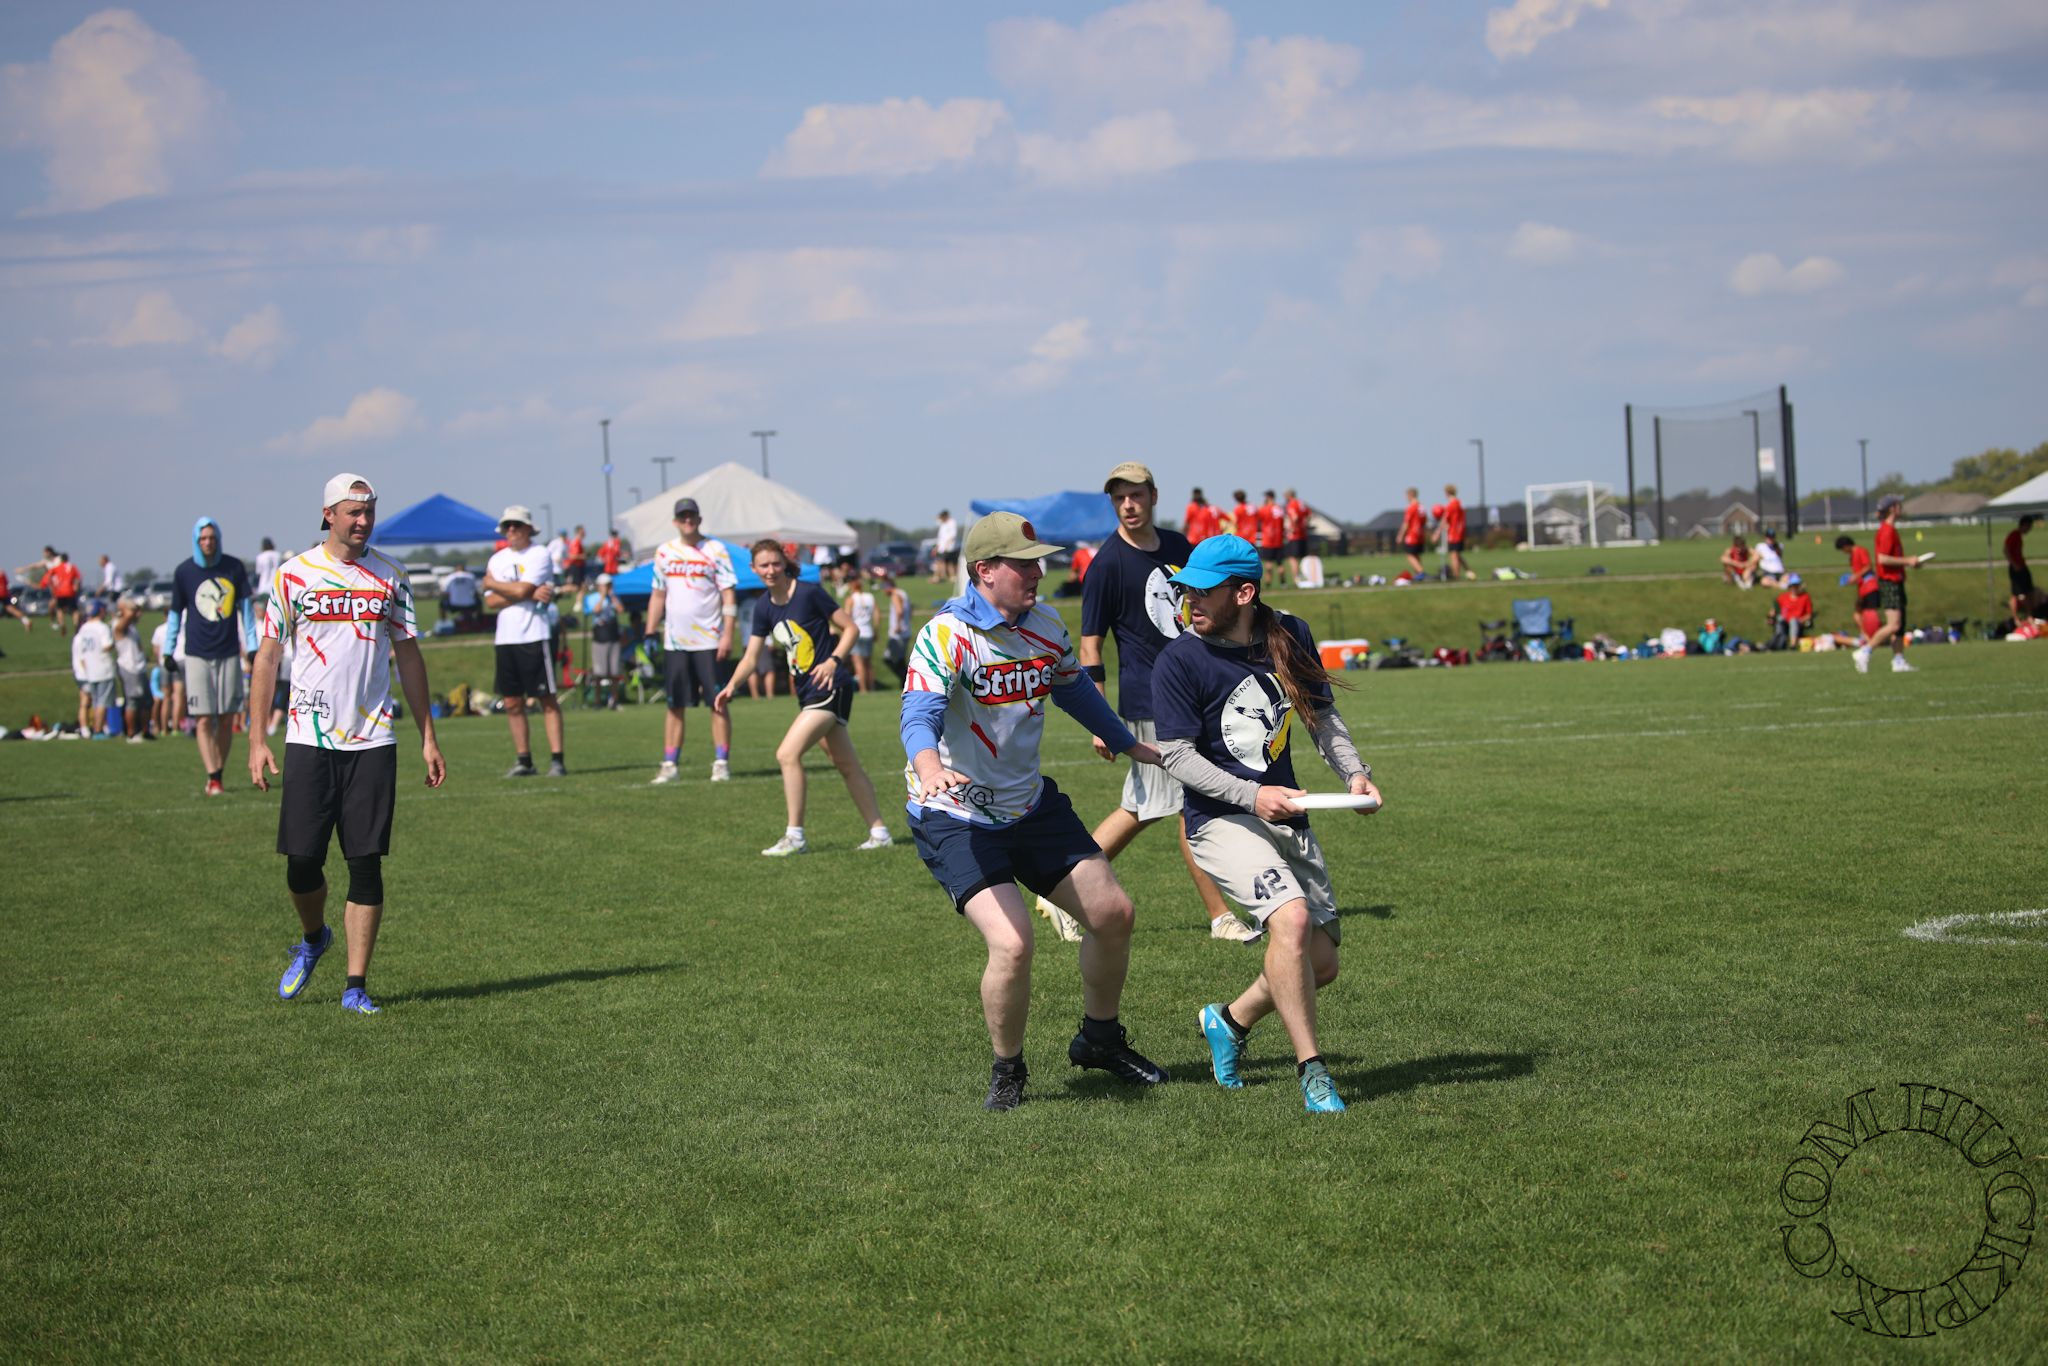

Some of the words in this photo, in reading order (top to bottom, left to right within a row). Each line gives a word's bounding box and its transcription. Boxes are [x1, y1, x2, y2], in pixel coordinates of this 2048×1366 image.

[302, 591, 390, 621] Stripes
[295, 689, 330, 718] 44
[1228, 679, 1252, 705] BEND
[1224, 724, 1246, 759] SOUTH
[1254, 868, 1288, 900] 42
